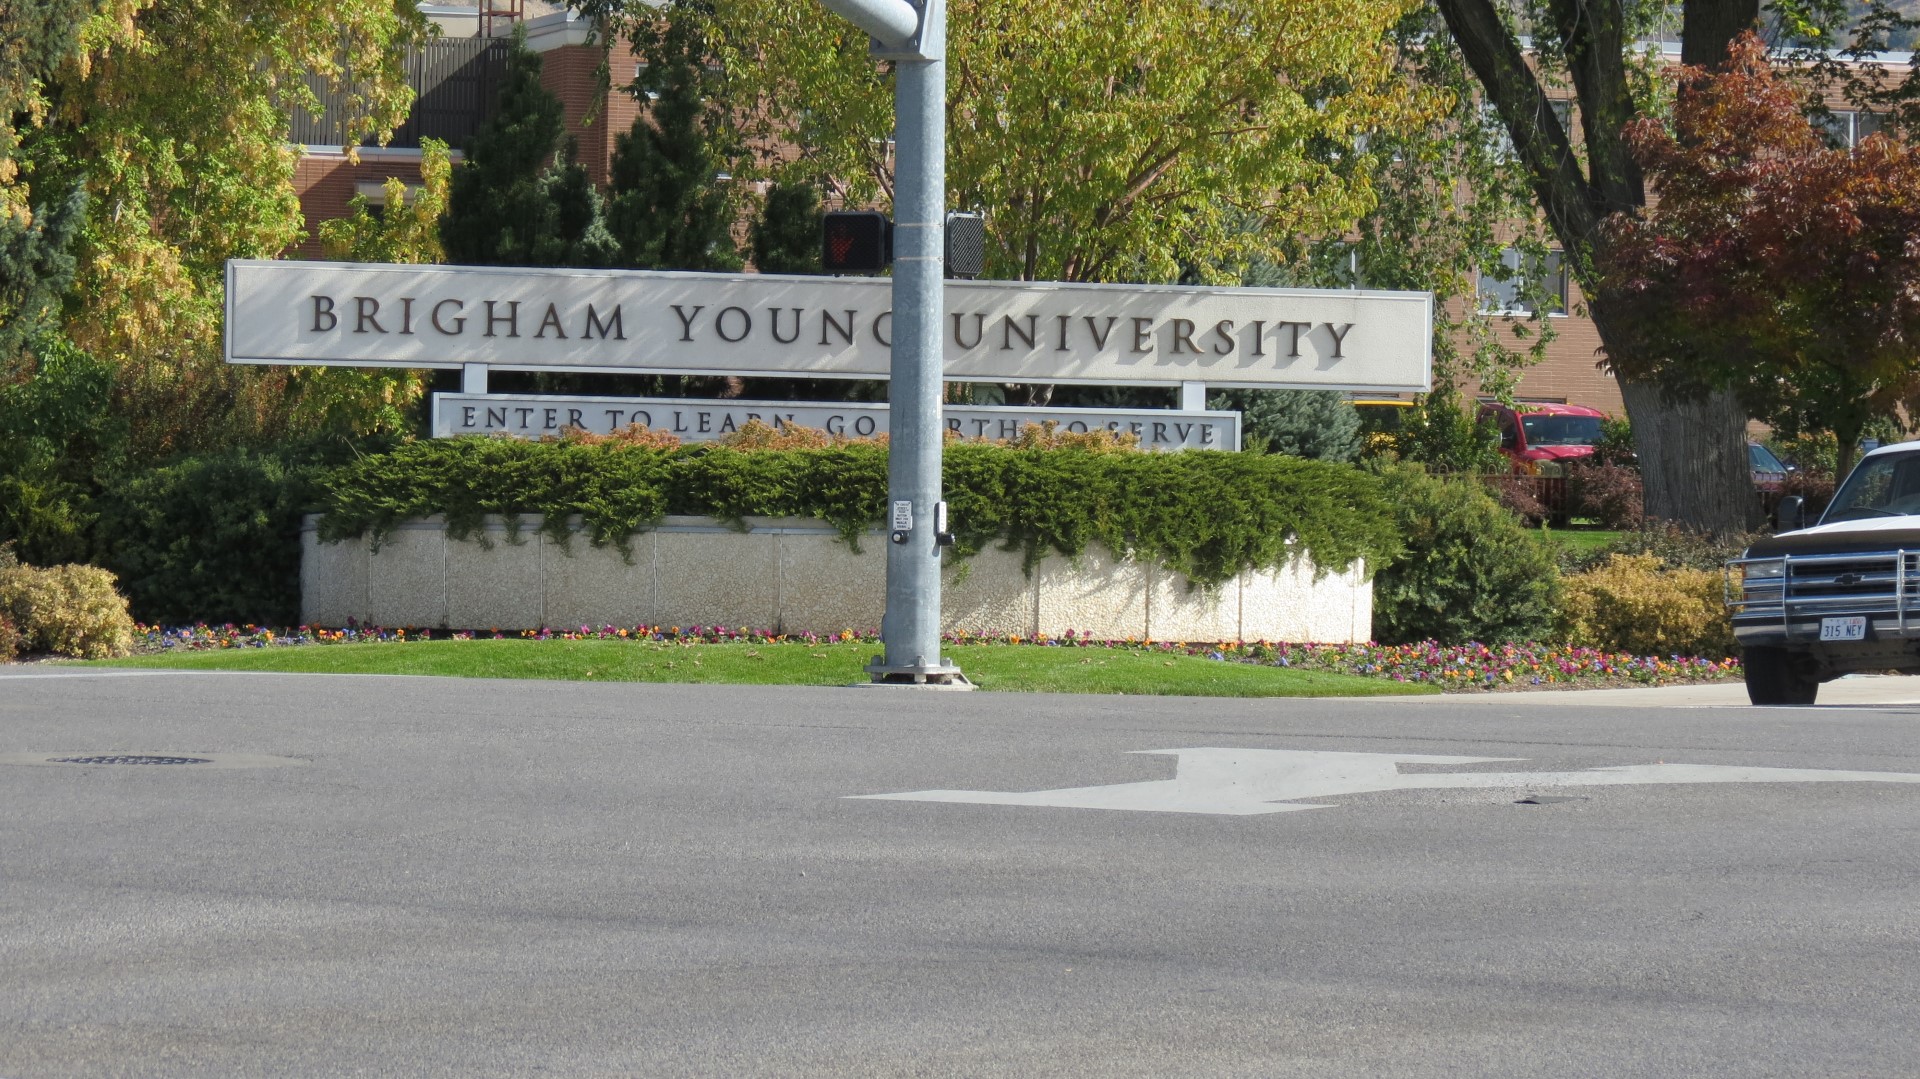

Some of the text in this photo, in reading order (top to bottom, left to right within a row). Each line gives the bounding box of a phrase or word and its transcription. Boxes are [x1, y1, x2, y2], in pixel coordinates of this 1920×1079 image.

[310, 295, 628, 341] BRIGHAM
[950, 311, 1356, 359] UNIVERSITY
[462, 406, 588, 430] ENTER
[605, 409, 652, 431] TO
[826, 415, 876, 436] GO
[946, 417, 1019, 439] RTH
[1107, 420, 1214, 444] SERVE
[1824, 625, 1841, 637] 315
